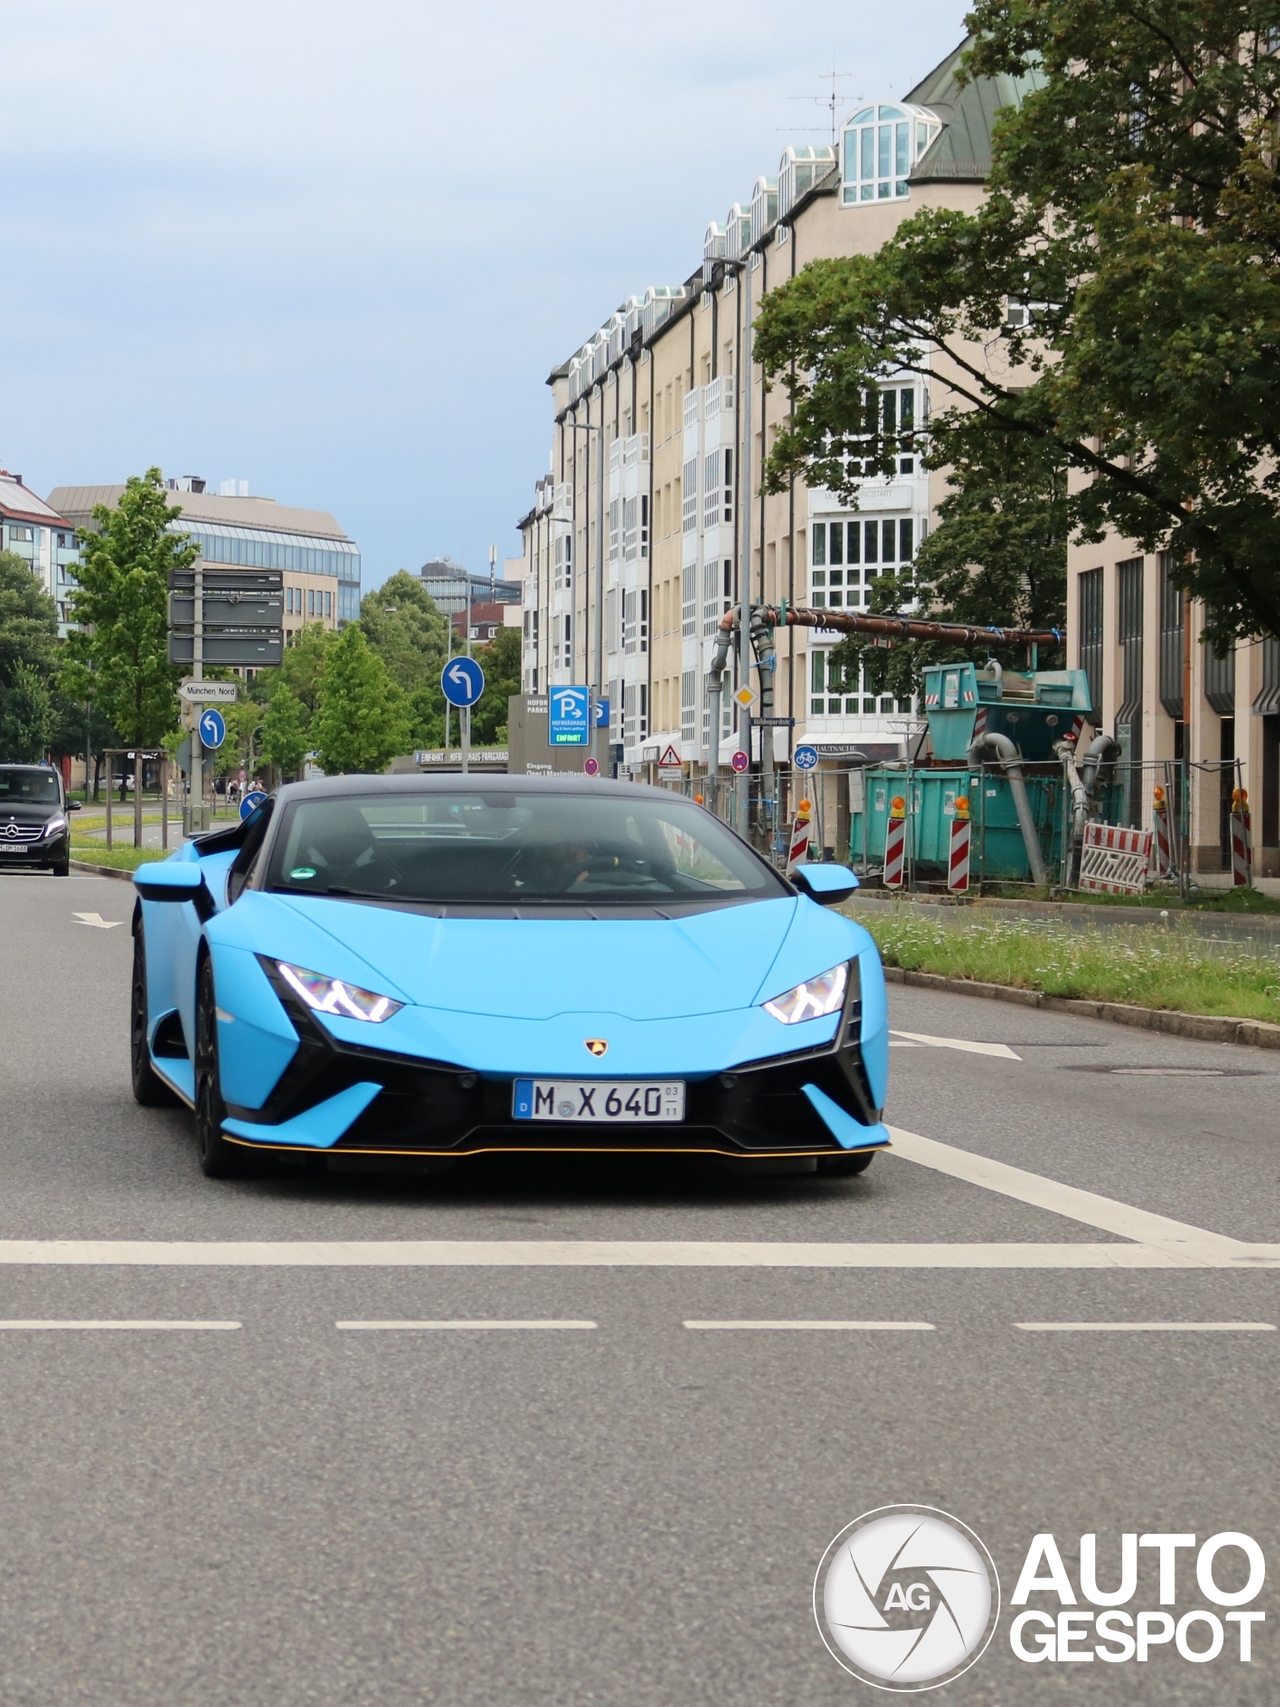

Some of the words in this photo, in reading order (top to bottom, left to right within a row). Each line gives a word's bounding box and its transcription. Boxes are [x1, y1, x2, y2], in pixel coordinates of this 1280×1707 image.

[187, 686, 216, 695] München
[219, 687, 235, 696] Nord
[556, 734, 582, 742] EINFAHRT
[526, 763, 552, 772] Eingang
[665, 1087, 678, 1096] 03
[520, 1103, 528, 1112] D
[534, 1086, 554, 1115] M
[578, 1087, 596, 1117] X
[605, 1087, 661, 1117] 640
[666, 1107, 677, 1116] 11
